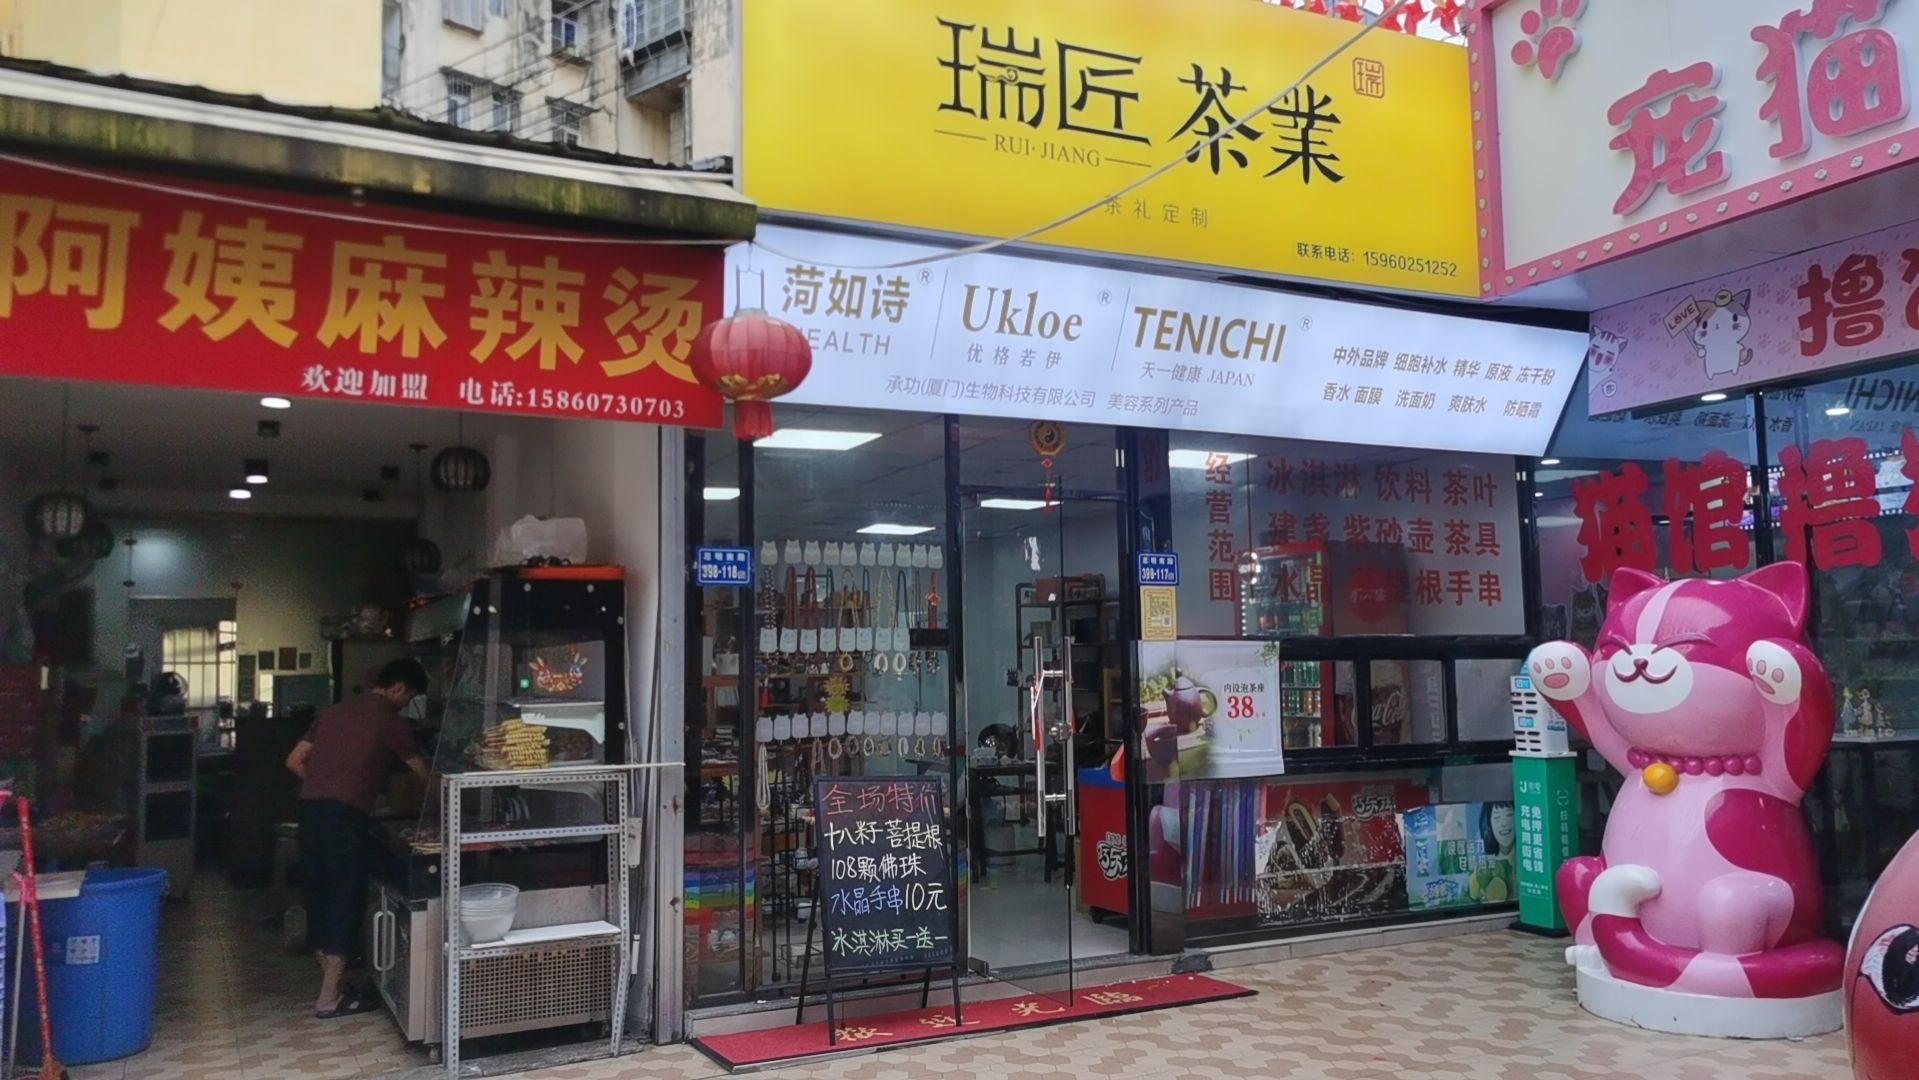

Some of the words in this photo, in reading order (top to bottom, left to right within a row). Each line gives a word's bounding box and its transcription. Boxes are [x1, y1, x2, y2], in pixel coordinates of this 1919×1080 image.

[1103, 194, 1207, 229] 茶礼定制
[0, 199, 703, 385] 阿姨麻辣烫
[962, 283, 1083, 342] Ukloe
[800, 327, 892, 356] EALTH
[1134, 306, 1287, 363] TENICHI
[966, 343, 1062, 370] 优格若伊
[1139, 361, 1202, 383] 天一健康
[1206, 368, 1256, 387] JAPAN
[1333, 346, 1389, 370] 中外品牌
[1393, 351, 1448, 376] 细胞补水
[1453, 359, 1481, 378] 精华
[1484, 362, 1513, 382] 原液
[1516, 366, 1556, 386] 冻干粉
[301, 364, 429, 400] 欢迎加盟
[1323, 382, 1351, 402] 香水
[1354, 386, 1384, 406] 面膜
[1395, 389, 1437, 410] 洗面奶
[1447, 394, 1488, 415] 爽肤水
[1106, 392, 1199, 417] 美容系列产品
[1266, 457, 1362, 499] 冰淇淋
[1374, 464, 1433, 505] 饮料
[1442, 468, 1498, 508] 茶叶
[1205, 451, 1235, 602] 经营范围
[1343, 513, 1435, 555] 紫砂壶
[1444, 519, 1500, 557] 茶具
[1227, 695, 1254, 719] 38
[822, 783, 938, 816] 全场特价
[830, 926, 949, 956] 冰淇淋买一送一
